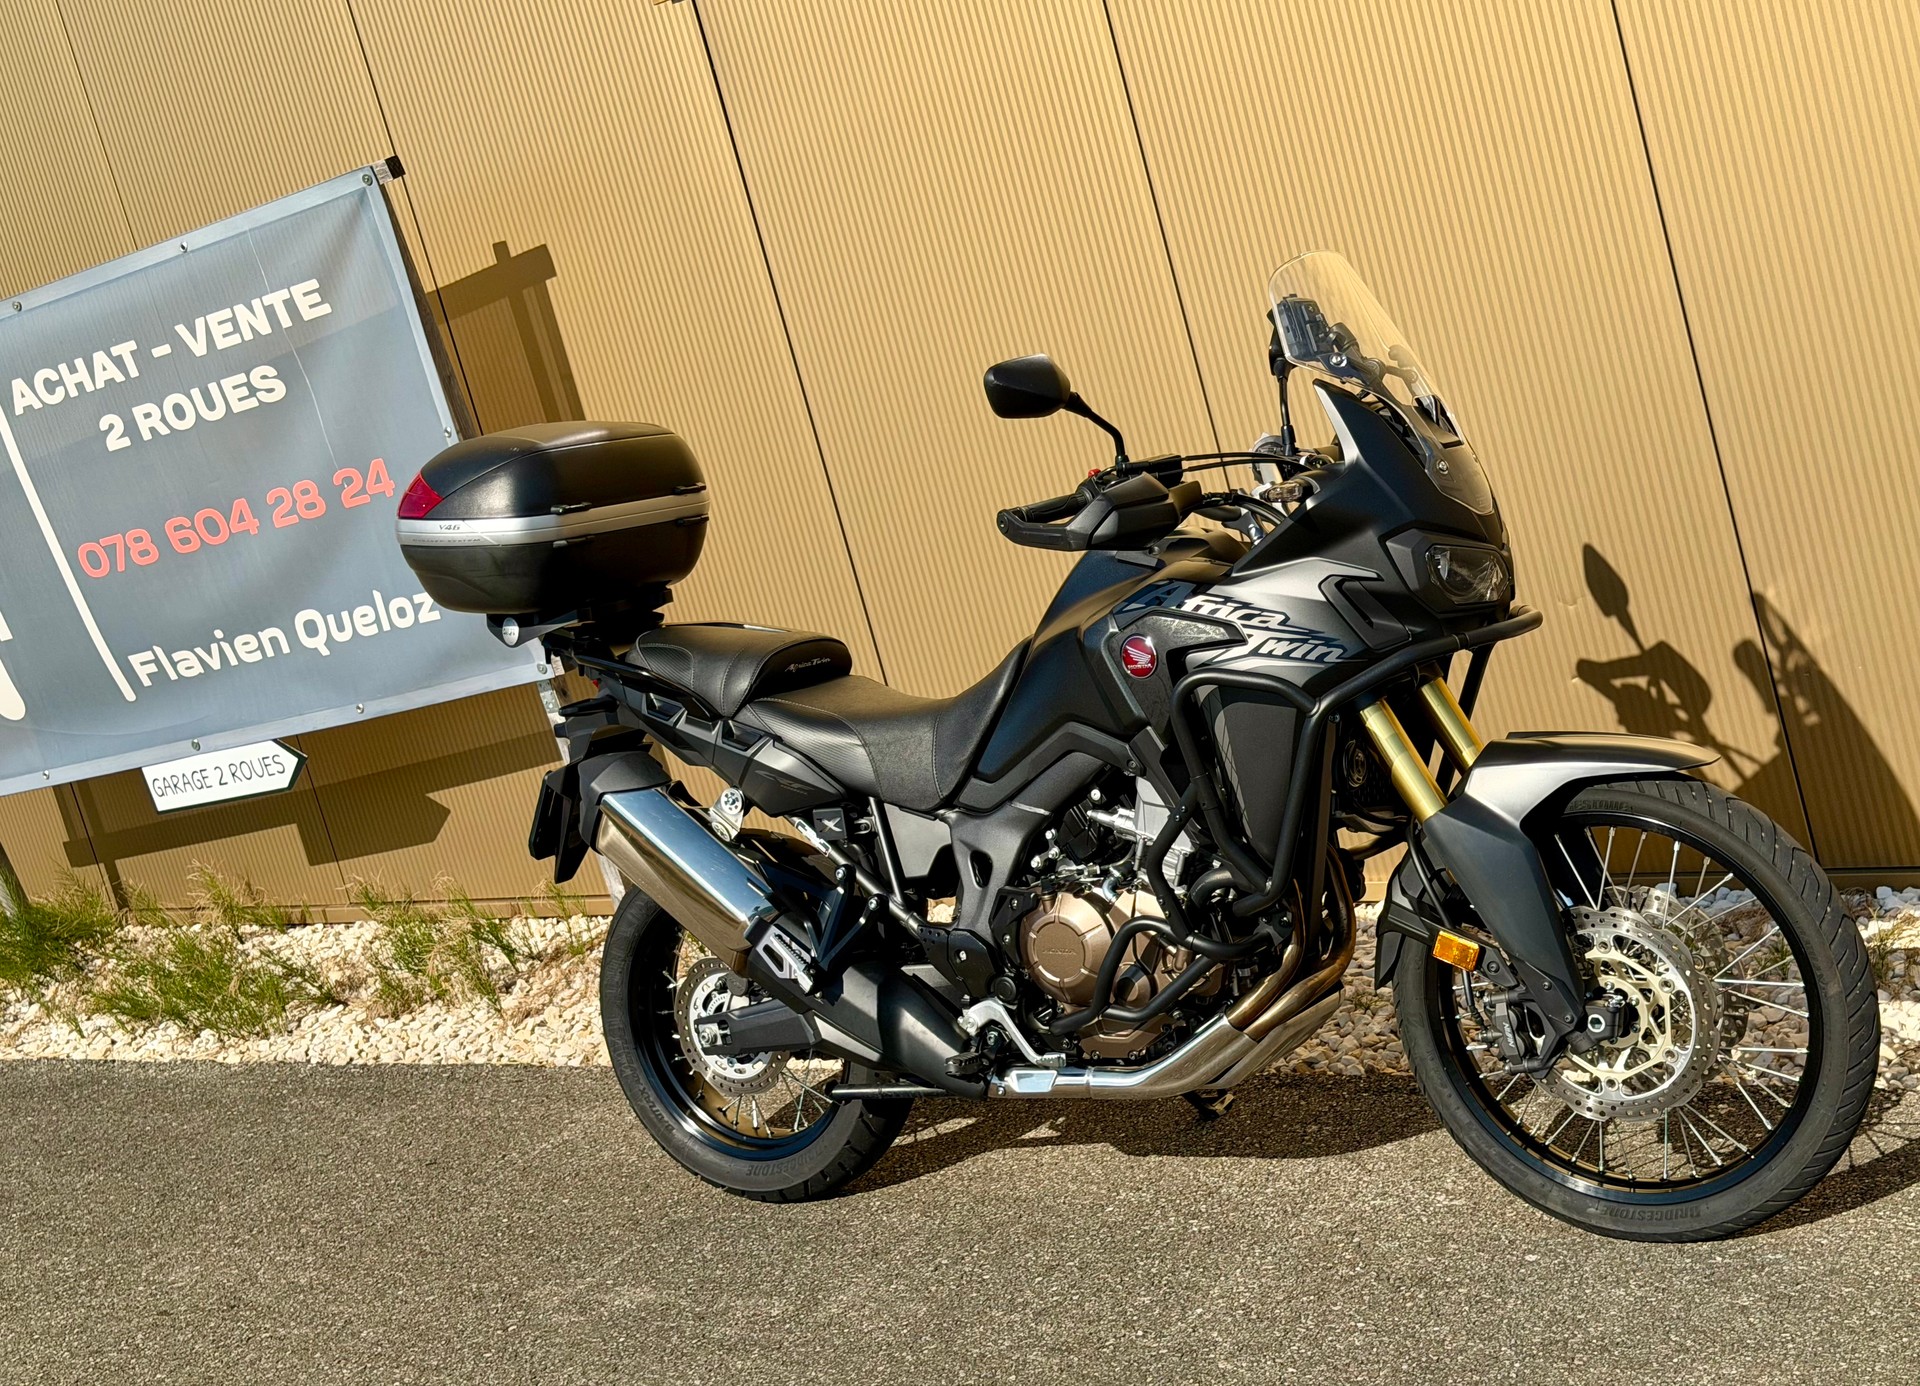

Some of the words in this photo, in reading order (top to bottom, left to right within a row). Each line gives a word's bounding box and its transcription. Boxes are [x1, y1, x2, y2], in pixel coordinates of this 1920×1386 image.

[11, 339, 140, 416] ACHAT
[150, 343, 172, 359] -
[174, 278, 333, 358] VENTE
[98, 413, 132, 452] 2
[131, 365, 287, 442] ROUES
[77, 528, 160, 579] 078
[164, 498, 260, 555] 604
[266, 479, 327, 528] 28
[332, 457, 396, 509] 24
[127, 627, 291, 687] Flavien
[294, 589, 442, 657] Queloz
[152, 768, 213, 798] GARAGE
[213, 765, 228, 786] 2
[228, 754, 286, 784] ROUES
[1600, 1205, 1701, 1221] BRIDGESTONE
